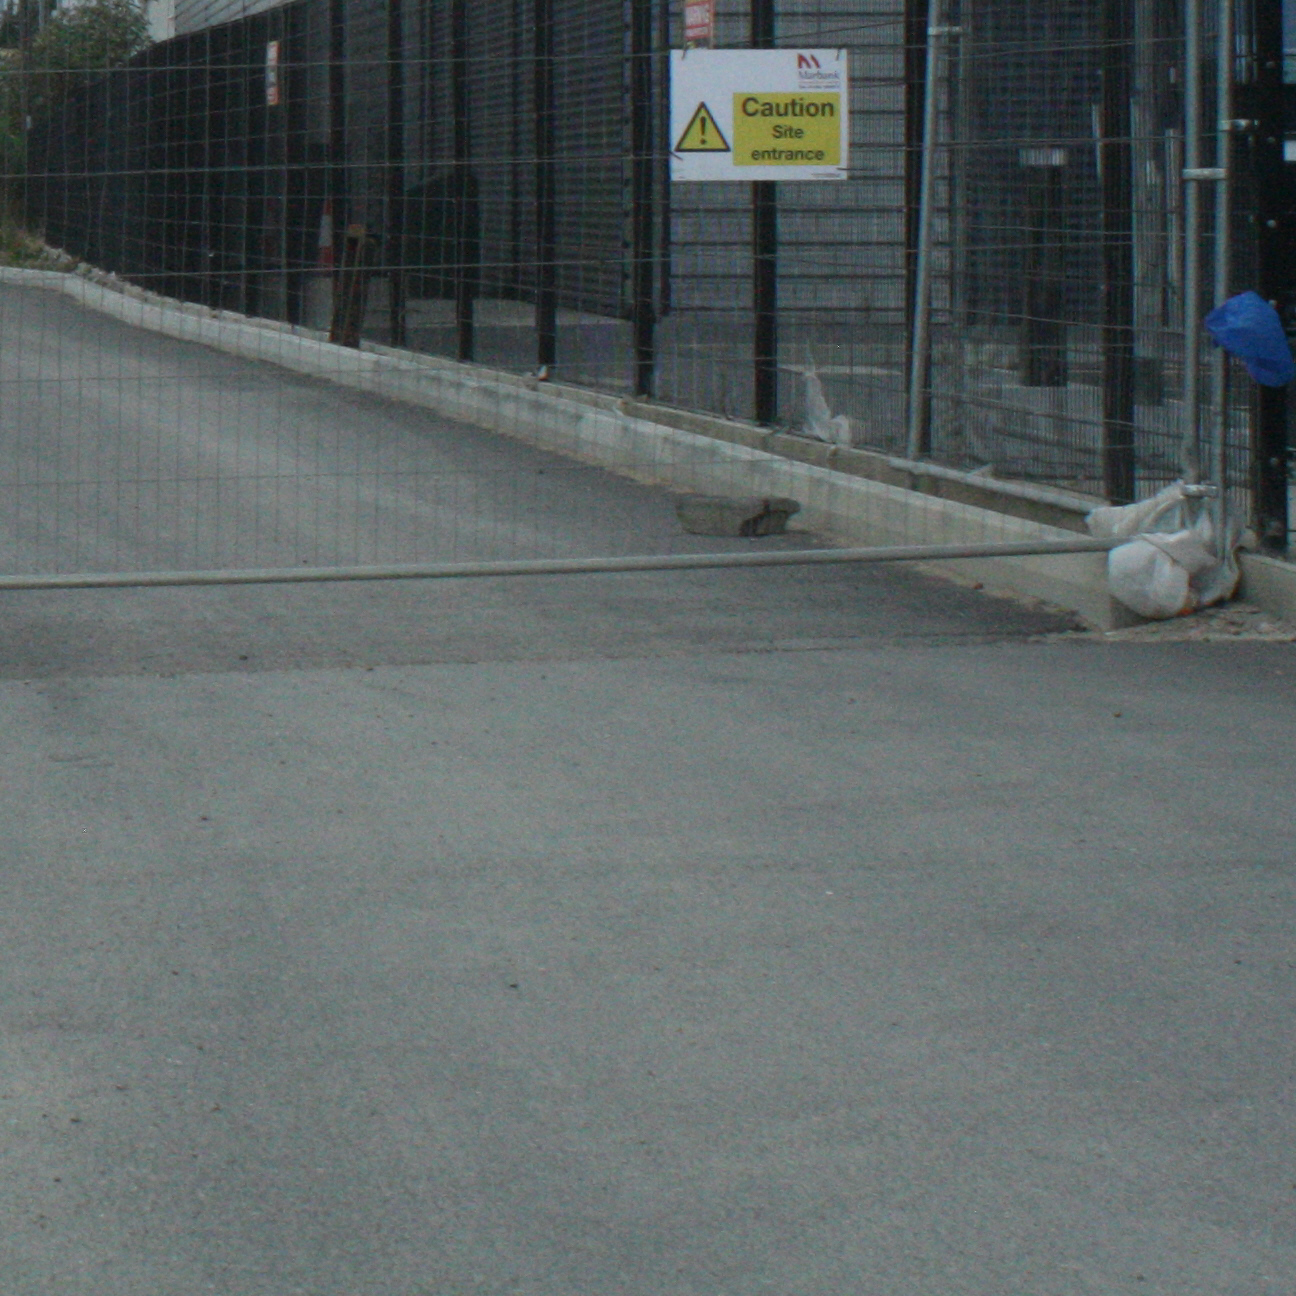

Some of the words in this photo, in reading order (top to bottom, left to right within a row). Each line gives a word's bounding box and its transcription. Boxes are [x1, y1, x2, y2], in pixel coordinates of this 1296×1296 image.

[741, 97, 835, 118] Caution
[772, 124, 804, 139] Site
[751, 148, 825, 161] entrance
